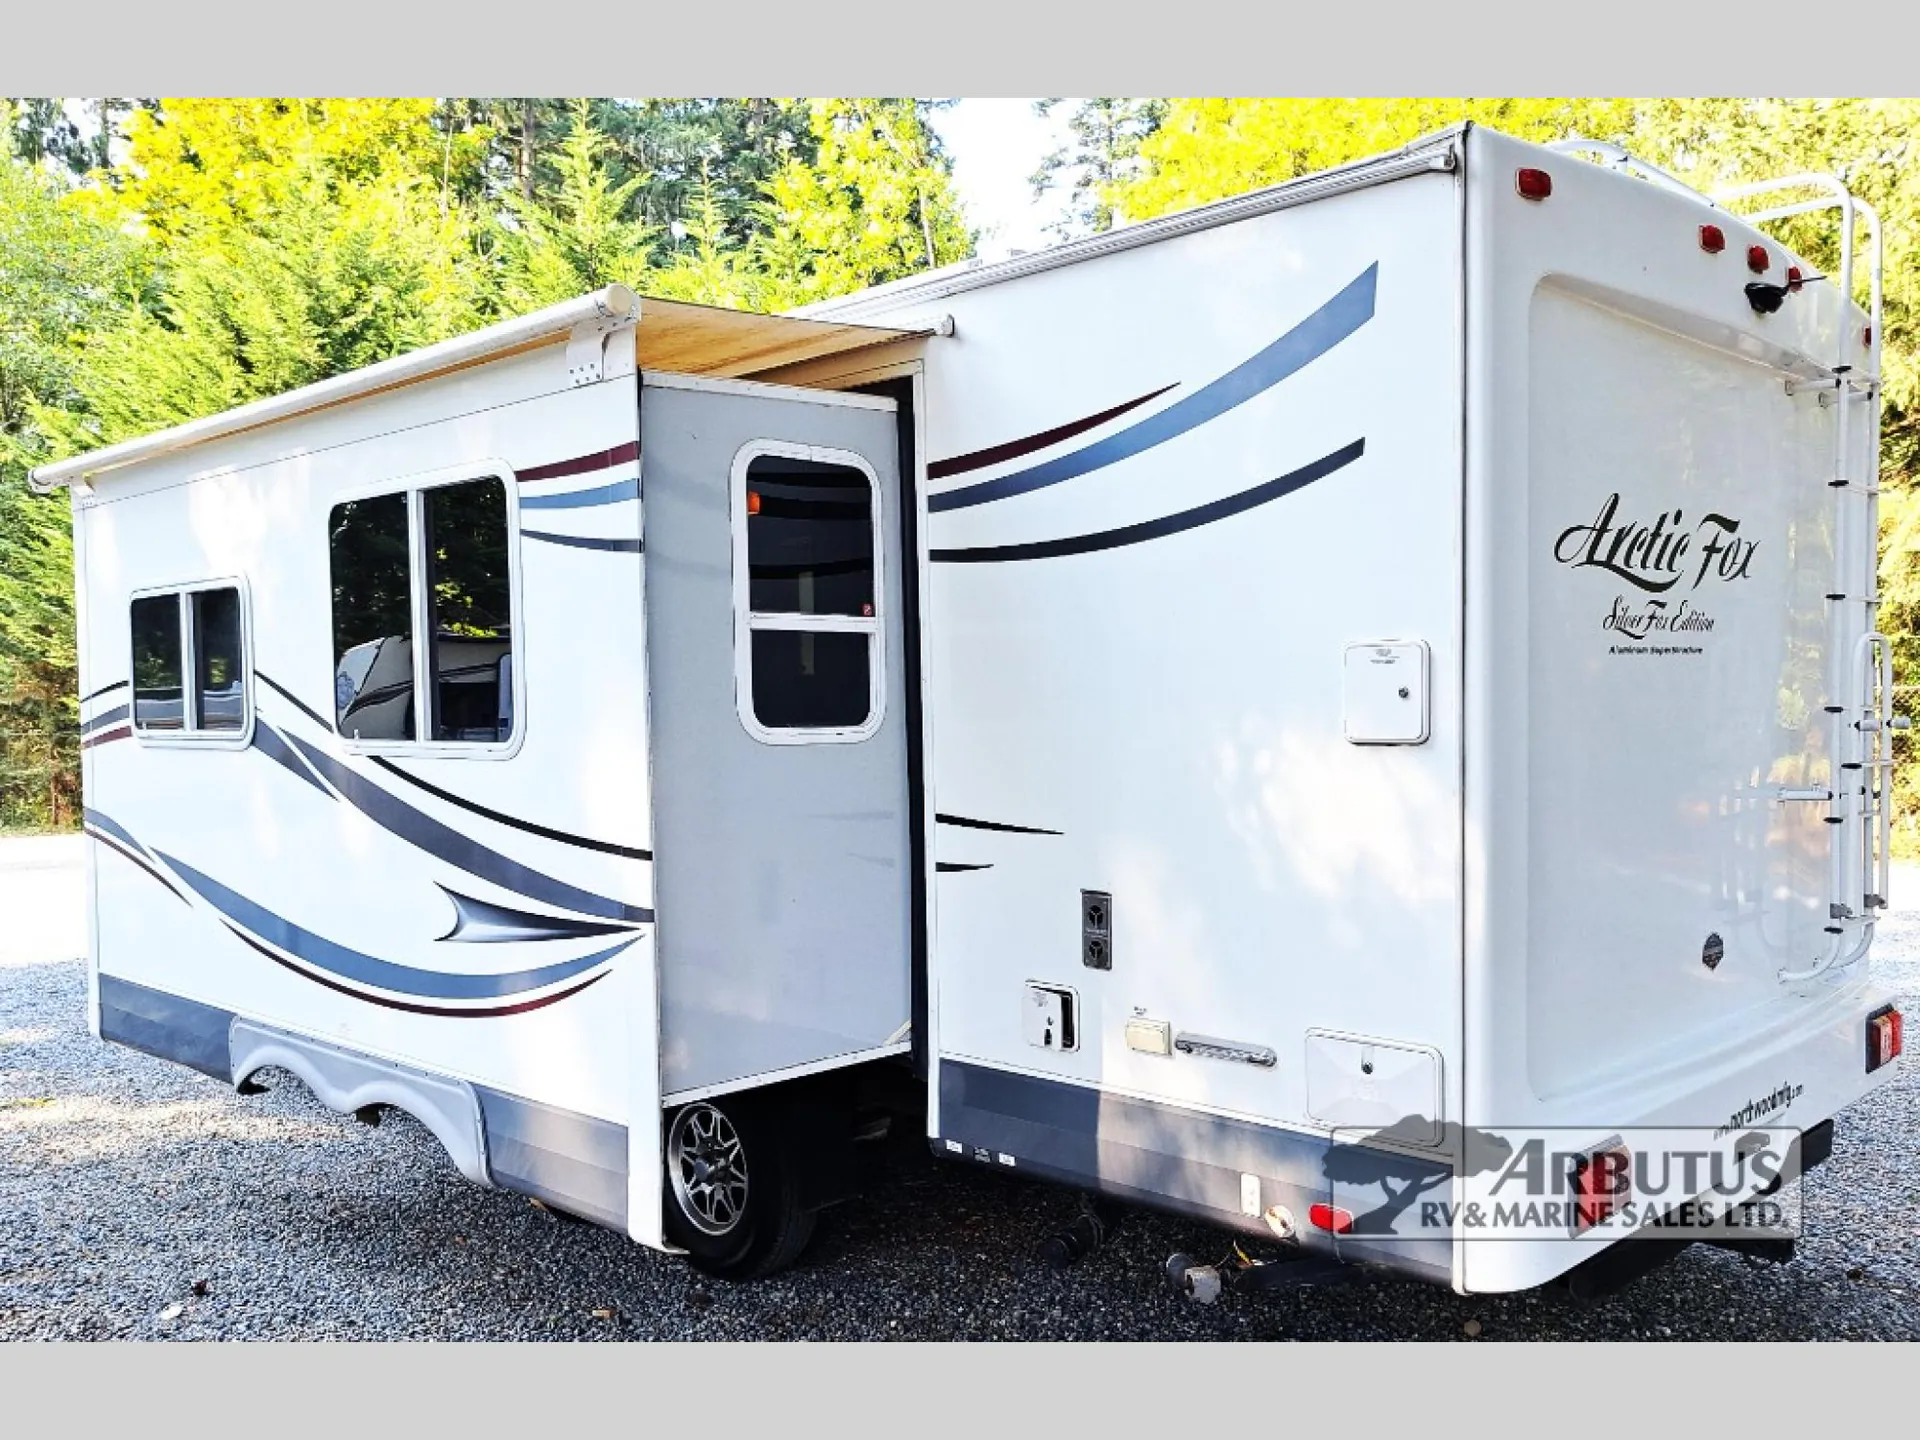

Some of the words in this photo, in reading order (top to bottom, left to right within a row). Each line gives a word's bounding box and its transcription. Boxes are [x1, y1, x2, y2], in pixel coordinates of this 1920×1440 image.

[1554, 493, 1690, 592] Arctic
[1691, 513, 1761, 590] Fox
[1603, 595, 1646, 640] Silver
[1643, 599, 1668, 632] Fox
[1671, 599, 1715, 632] Edition
